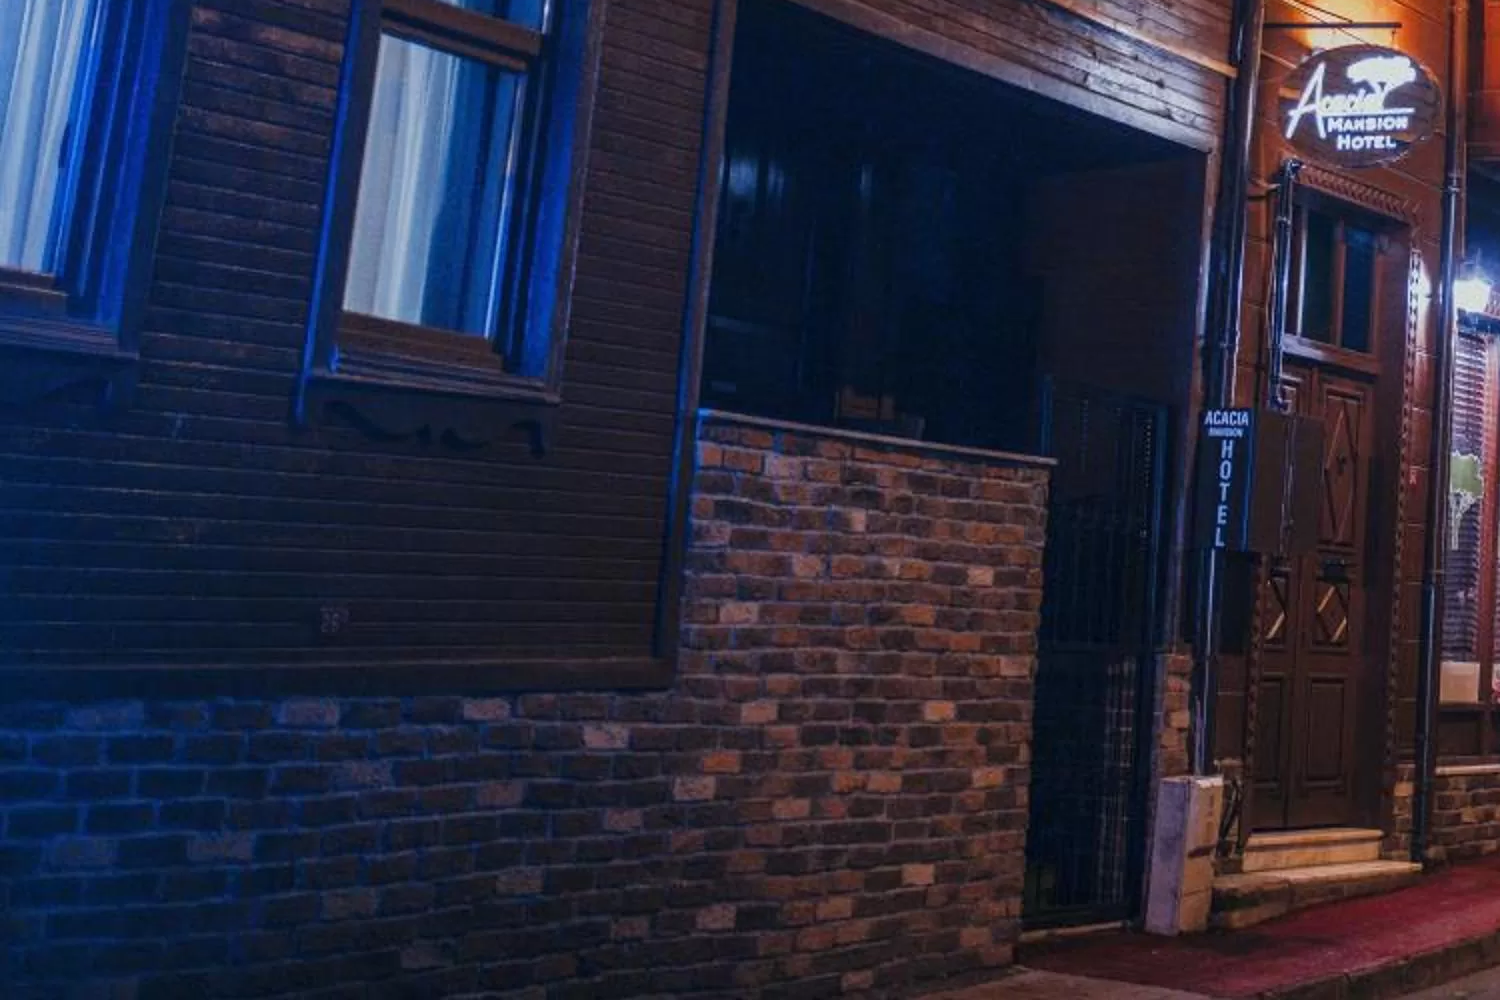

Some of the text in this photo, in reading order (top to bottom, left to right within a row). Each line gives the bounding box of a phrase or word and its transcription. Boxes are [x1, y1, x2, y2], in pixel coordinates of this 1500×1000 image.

[1327, 116, 1408, 133] MANSION
[1336, 135, 1397, 150] HOTEL
[1204, 410, 1249, 426] ACACIA
[1215, 439, 1233, 547] HOTEL
